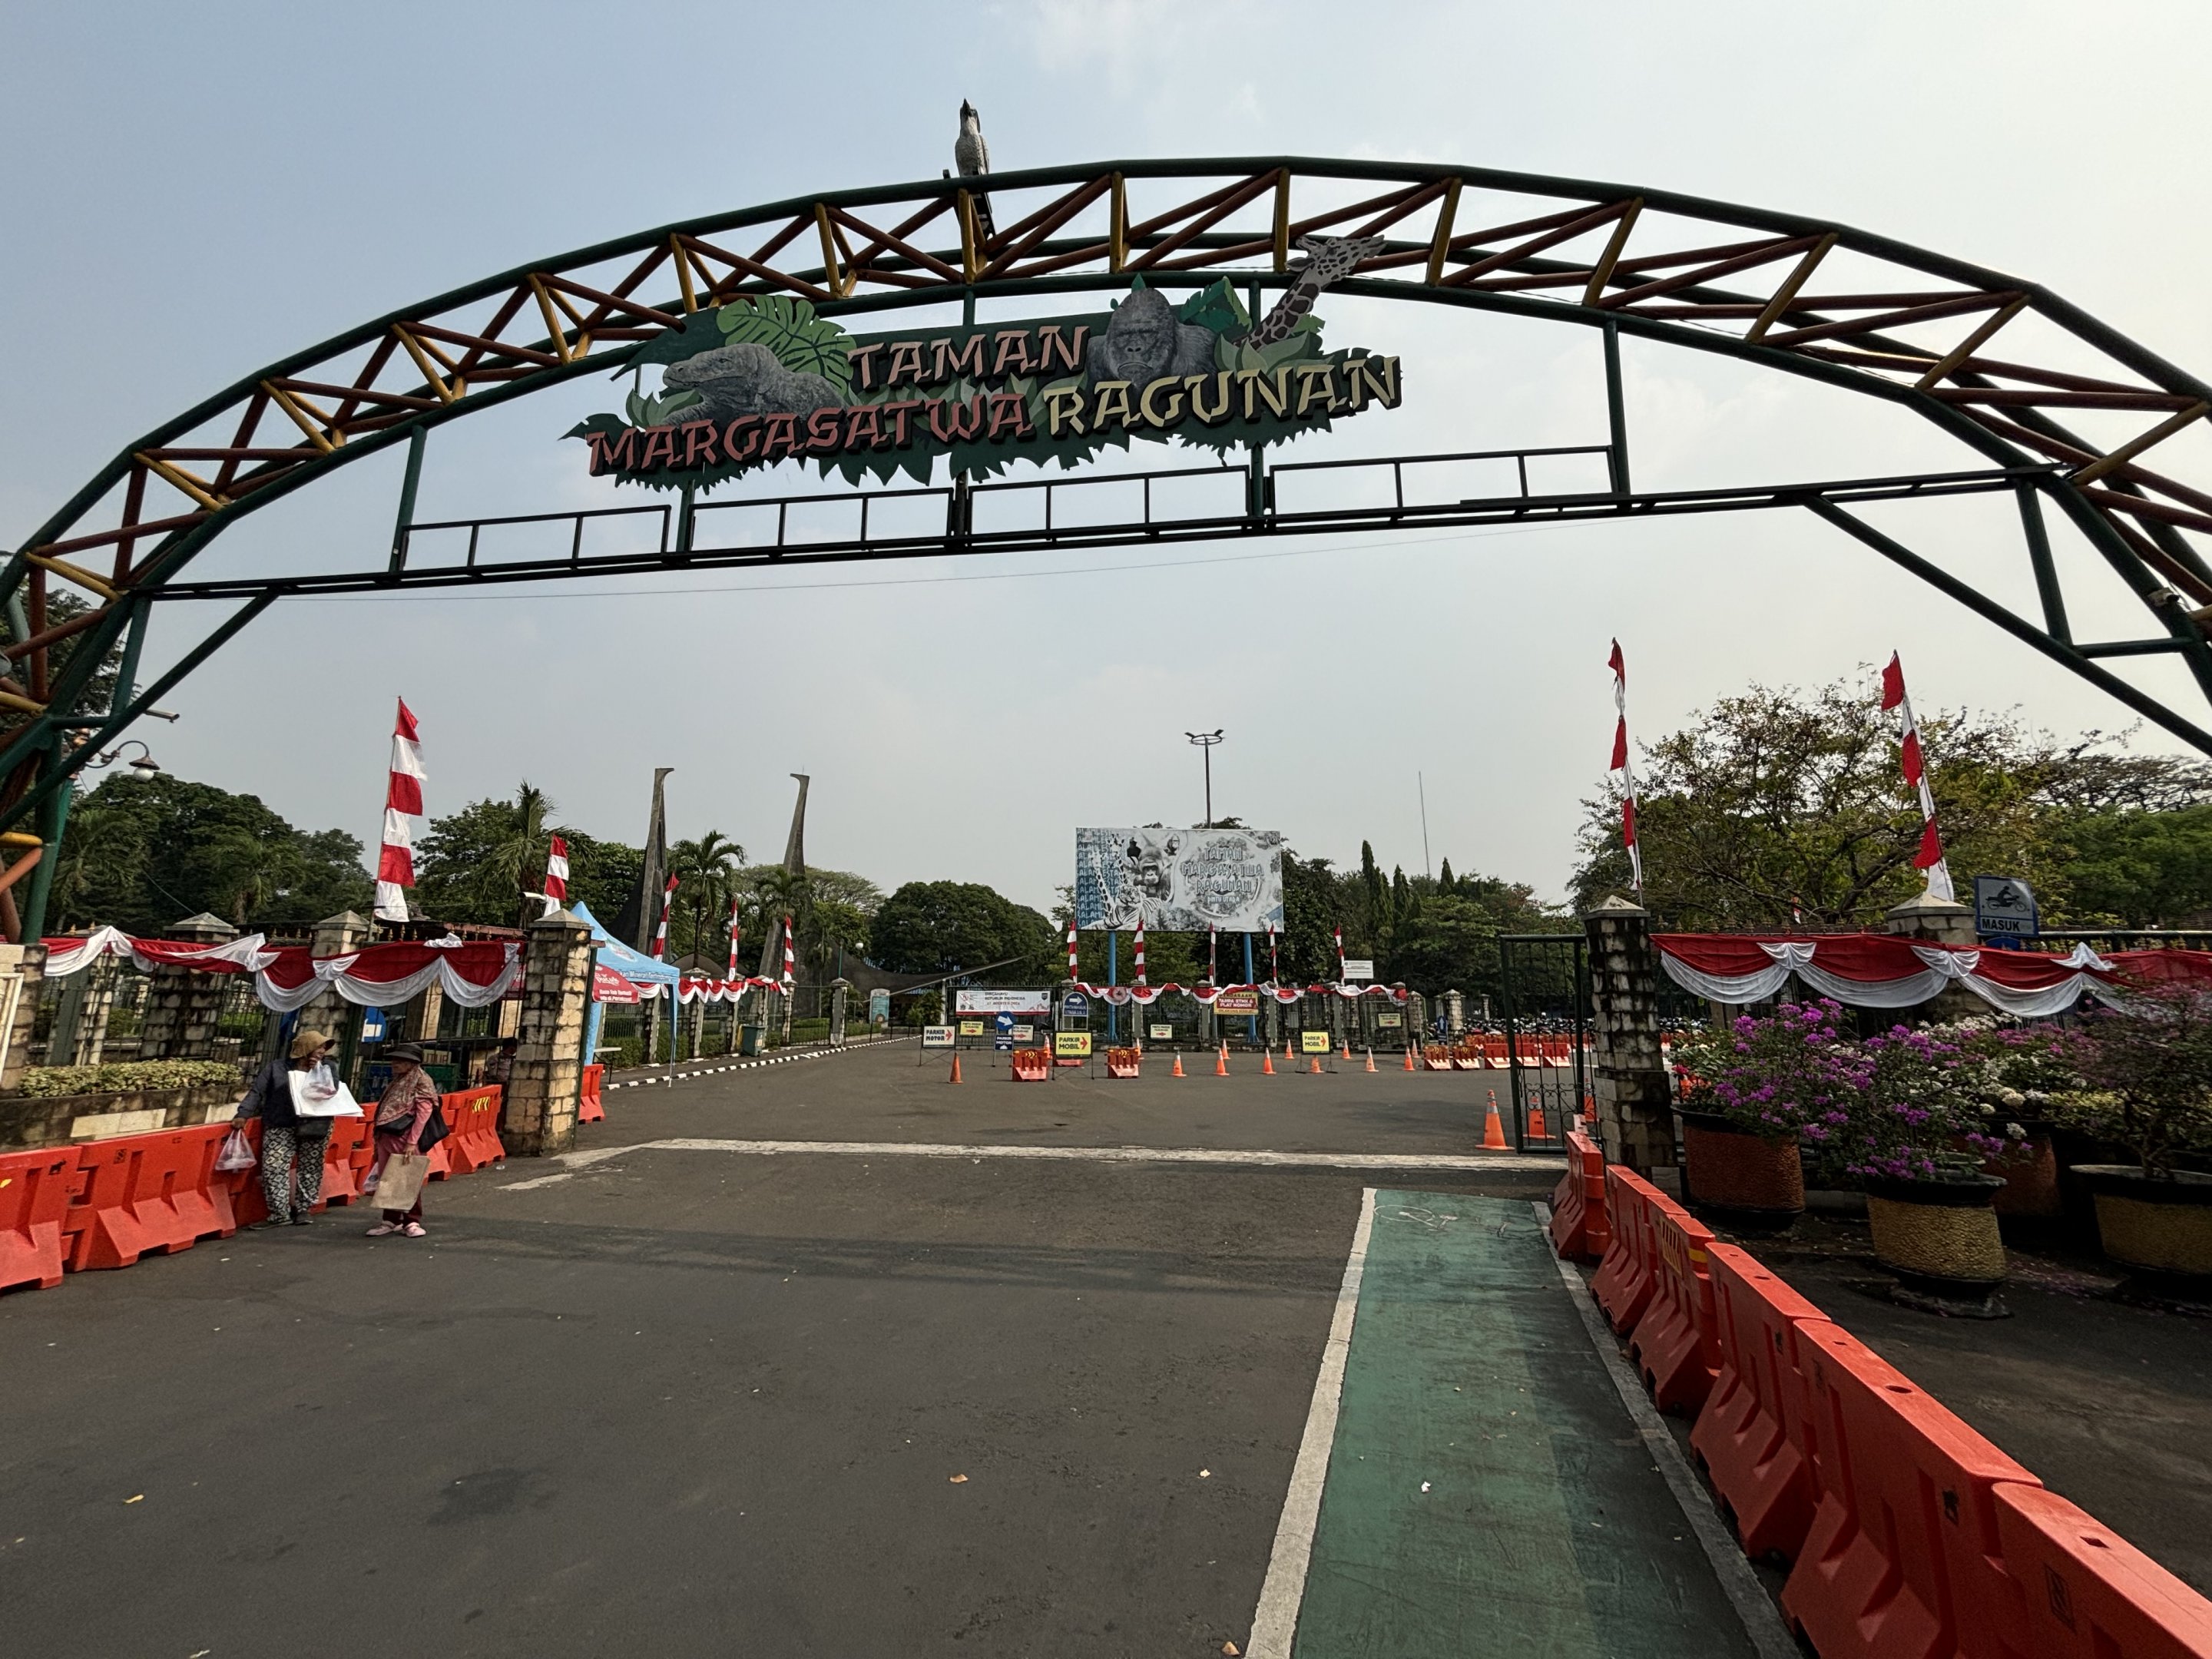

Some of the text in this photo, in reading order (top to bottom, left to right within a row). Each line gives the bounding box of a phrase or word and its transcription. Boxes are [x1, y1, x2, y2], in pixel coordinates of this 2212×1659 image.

[848, 325, 1089, 390] TAMAN
[586, 355, 1402, 476] MARGASATWA RAGUNAN
[1204, 846, 1243, 860] TAMAN
[1181, 862, 1264, 879] MARGASATWA
[1196, 878, 1252, 896] RAGUNAN
[1982, 919, 2020, 932] MASUK
